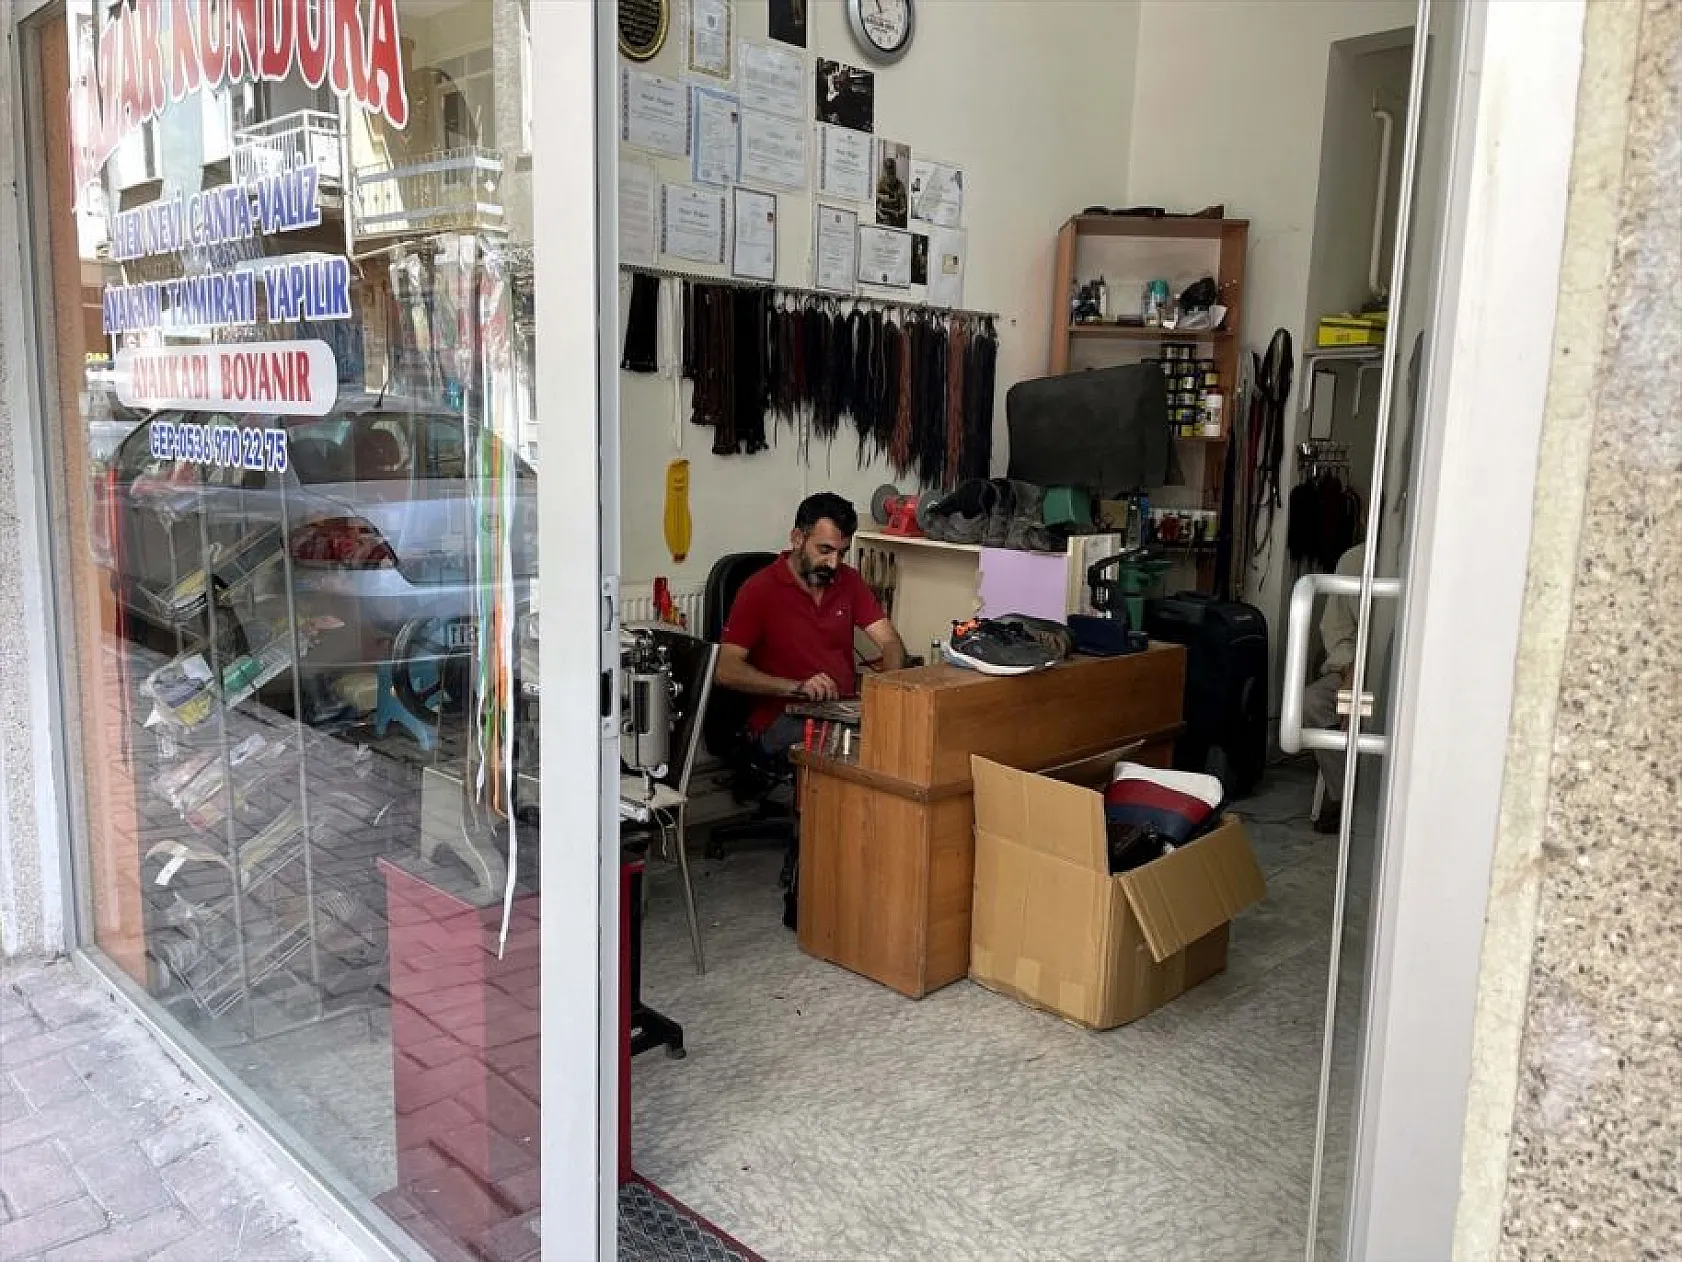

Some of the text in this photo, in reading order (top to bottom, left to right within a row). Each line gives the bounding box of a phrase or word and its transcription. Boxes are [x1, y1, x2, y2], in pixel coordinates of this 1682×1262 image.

[264, 258, 351, 322] YAPILIR
[220, 351, 312, 402] BOYANIR
[214, 425, 240, 468] 970
[242, 428, 264, 470] 22
[265, 428, 289, 475] 75
